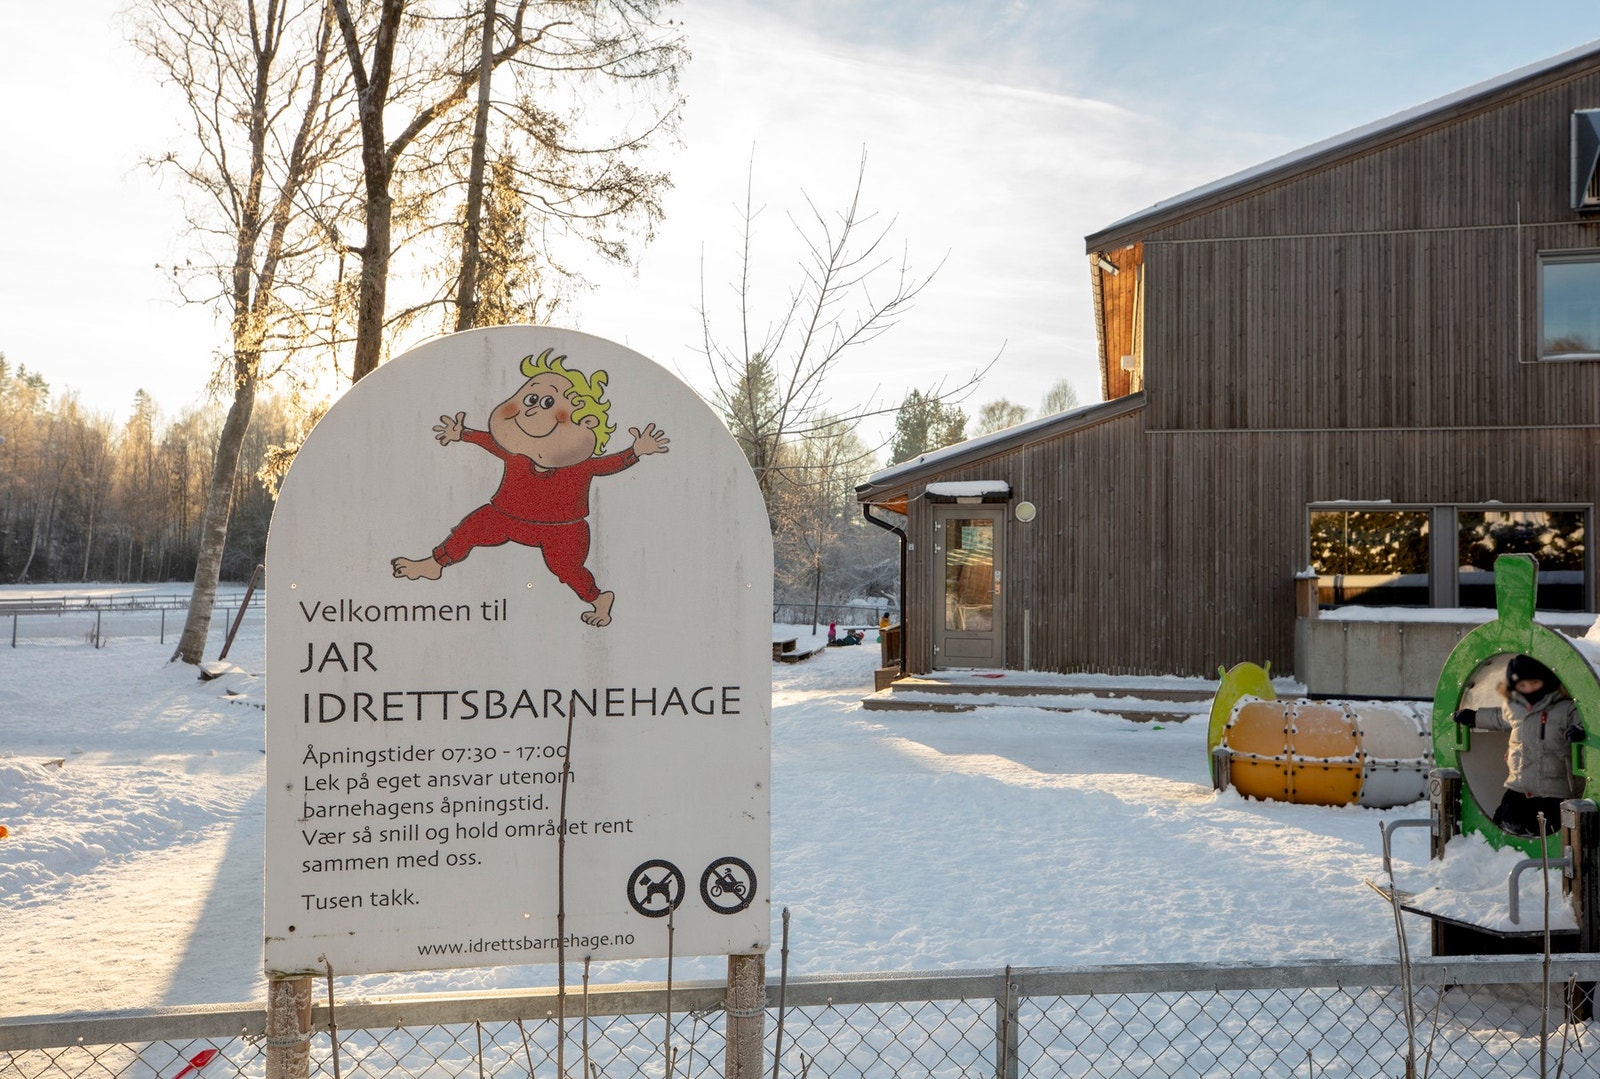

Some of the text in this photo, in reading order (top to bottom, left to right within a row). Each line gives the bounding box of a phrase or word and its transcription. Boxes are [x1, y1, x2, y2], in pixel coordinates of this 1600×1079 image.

[299, 598, 507, 623] Velkommen til
[300, 642, 378, 673] JAR
[304, 686, 741, 723] IDRETTSBARNEHAGE
[302, 744, 435, 768] Åpningstider
[441, 747, 497, 763] 07:30
[516, 745, 568, 761] 17:00
[304, 771, 575, 794] Lek på eget ansvar utenom
[303, 794, 549, 820] barnehagens åpningstid.
[302, 819, 633, 846] Vær så snill og hold området rent
[302, 850, 482, 873] sammen med oss.
[301, 888, 420, 910] Tusen takk.
